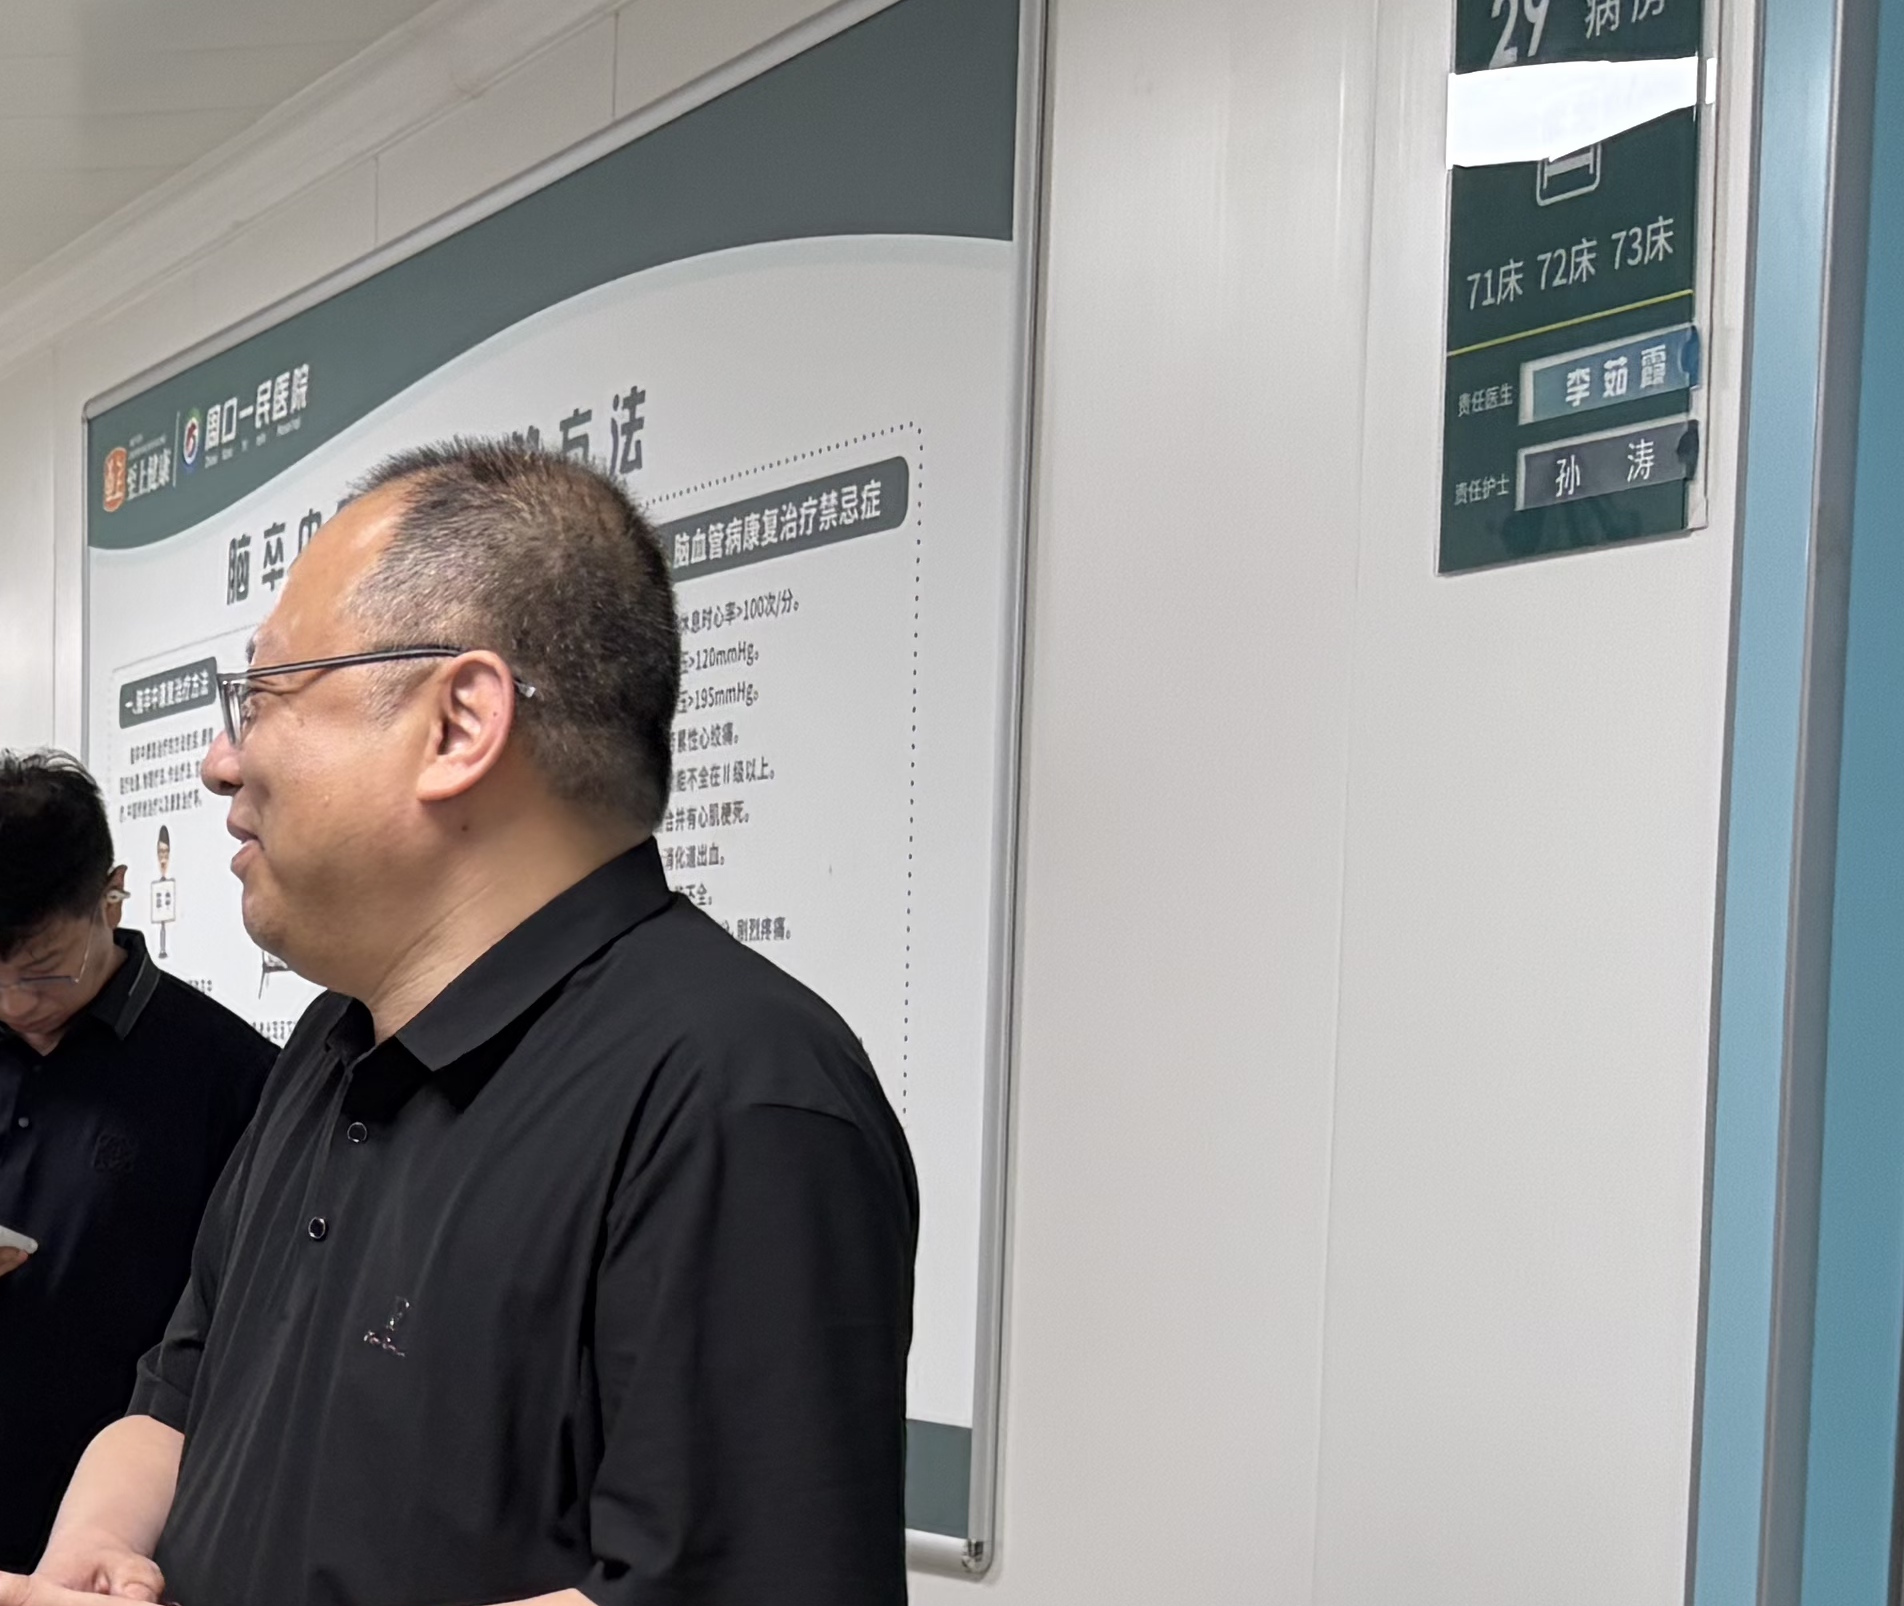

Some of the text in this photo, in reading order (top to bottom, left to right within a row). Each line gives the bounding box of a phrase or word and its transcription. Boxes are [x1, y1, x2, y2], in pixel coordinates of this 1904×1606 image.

[1467, 216, 1674, 310] 71床 72床 73床
[204, 363, 310, 451] 周口一民医院
[1458, 383, 1513, 417] 责任医生
[673, 479, 882, 569] 脑血管病康复治疗禁忌症
[1454, 474, 1510, 506] 责任护士
